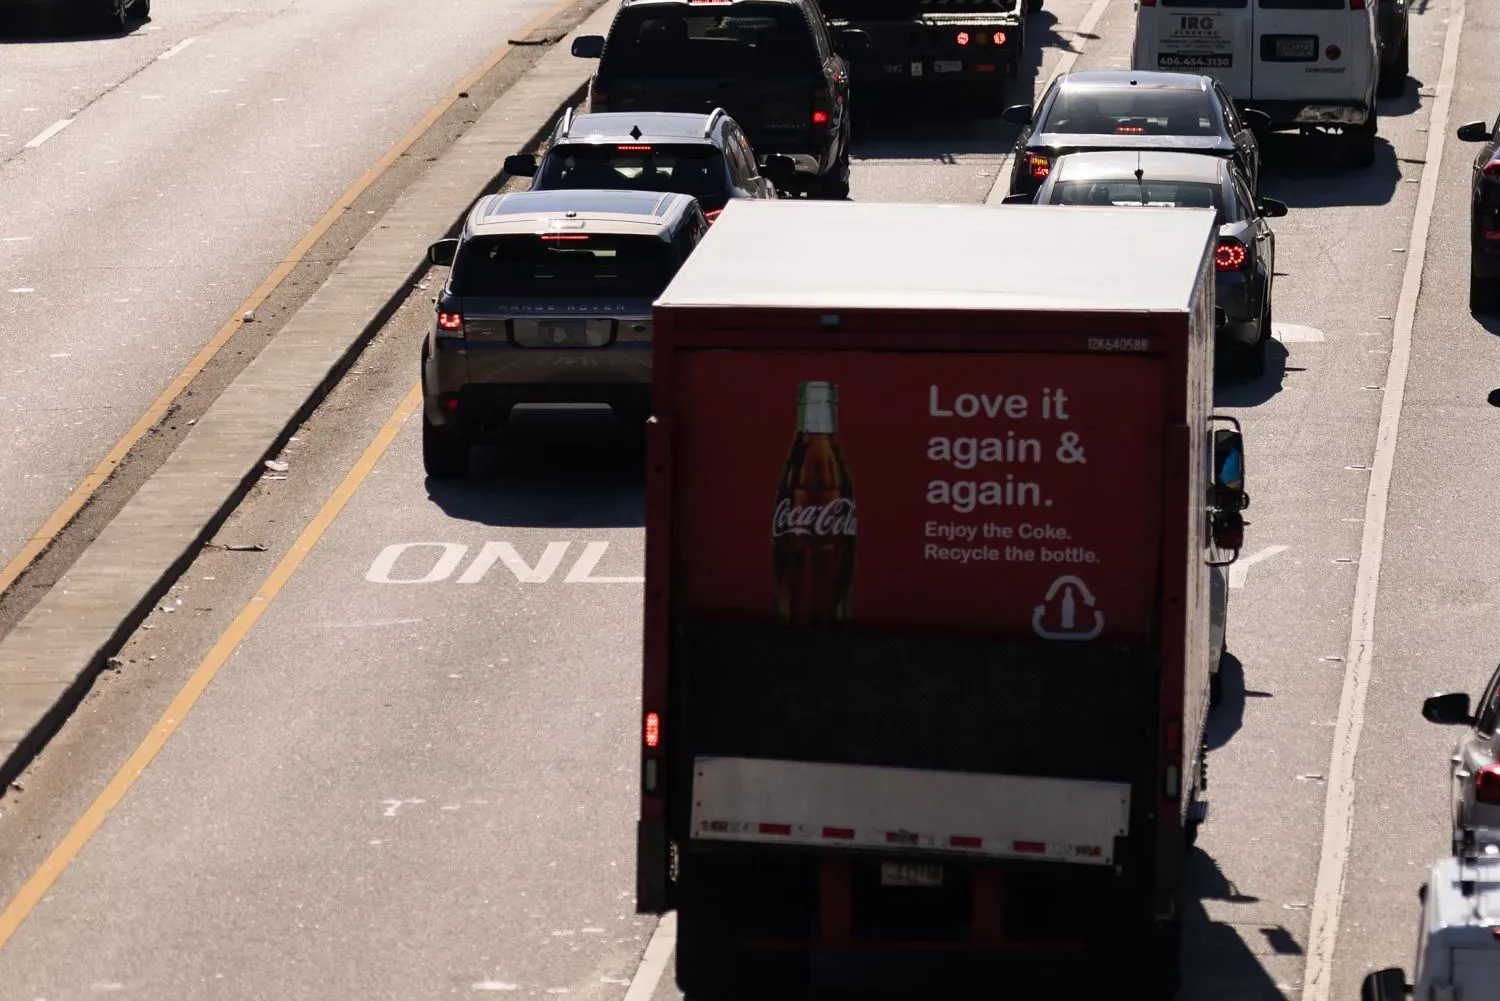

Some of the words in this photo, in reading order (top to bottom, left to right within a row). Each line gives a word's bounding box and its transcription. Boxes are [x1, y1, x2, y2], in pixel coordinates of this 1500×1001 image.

[1180, 15, 1214, 30] IRG
[498, 303, 555, 312] RANGE
[567, 303, 625, 312] ROVER
[929, 384, 1029, 419] Love
[1041, 387, 1071, 420] it
[926, 430, 1041, 469] again
[1056, 431, 1087, 464] &
[926, 474, 1054, 513] again.
[771, 497, 858, 537] Coca-Cola
[925, 521, 978, 541] Enjoy
[982, 522, 1013, 539] the
[1018, 523, 1072, 540] Coke.
[364, 541, 645, 584] ONL
[924, 543, 1000, 564] Recycle
[1004, 545, 1035, 562] the
[1040, 546, 1101, 564] bottle.
